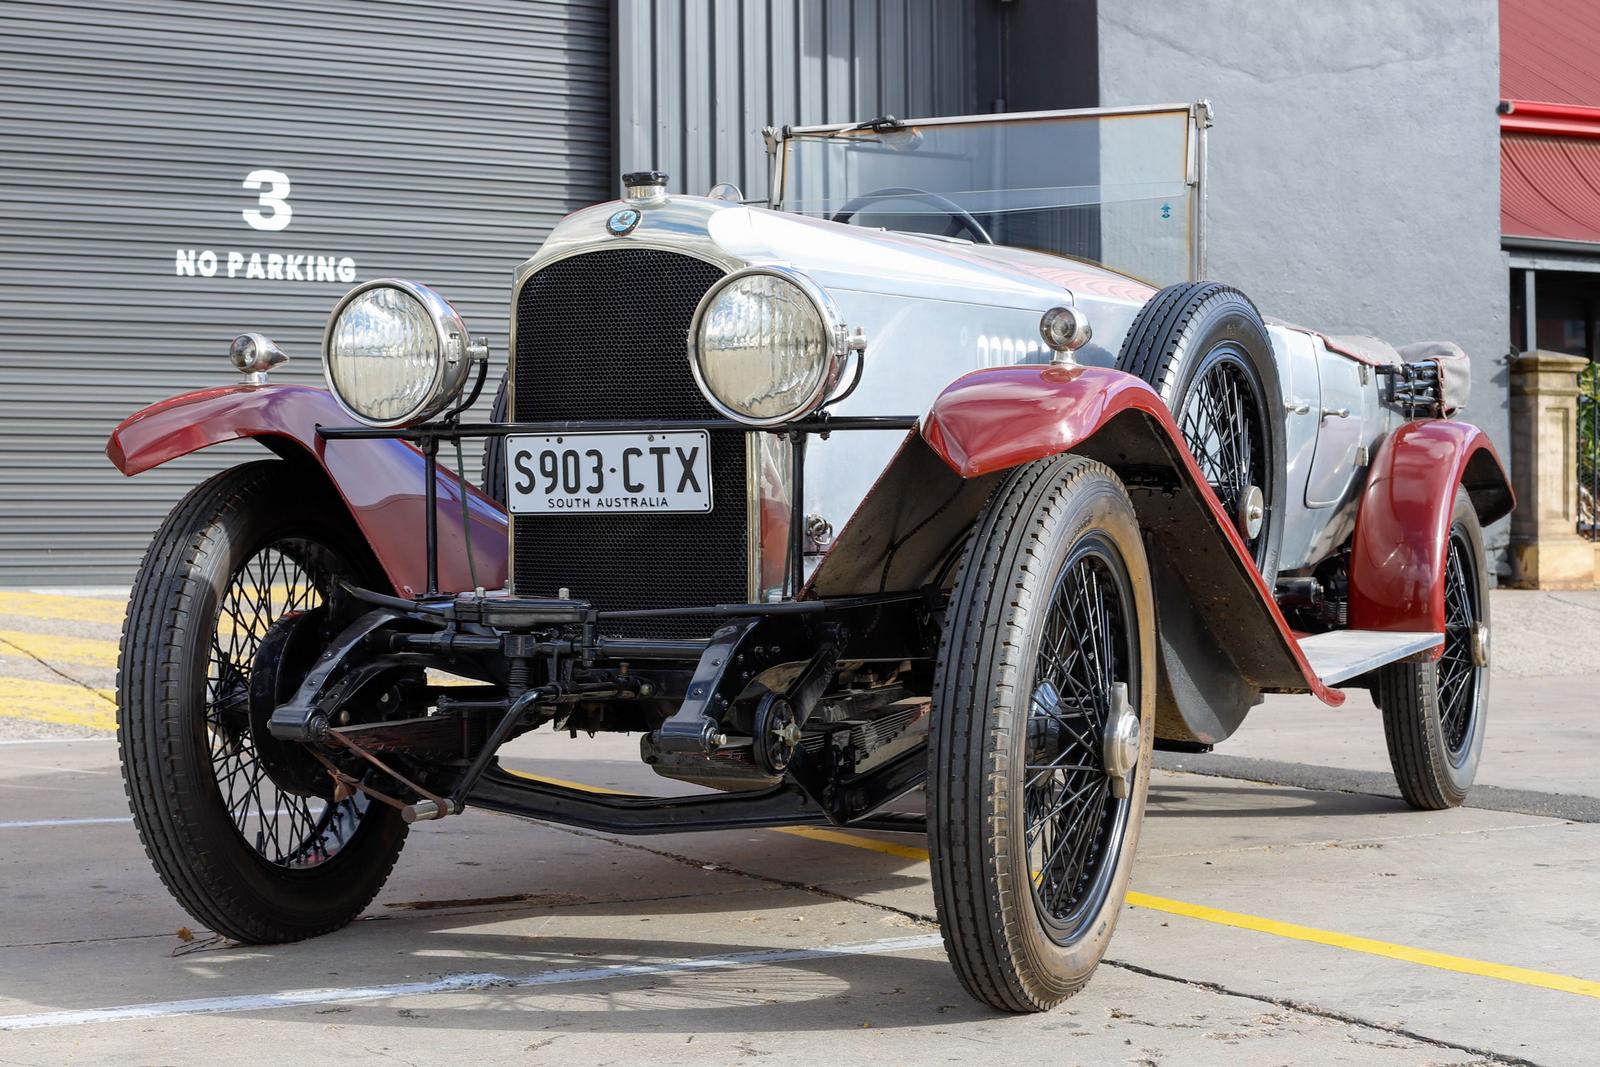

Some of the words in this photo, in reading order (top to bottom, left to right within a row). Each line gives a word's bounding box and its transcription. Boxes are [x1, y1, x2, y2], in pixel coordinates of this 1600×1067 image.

[242, 170, 293, 231] 3
[176, 249, 218, 277] NO
[227, 252, 356, 282] PARKING
[548, 498, 590, 508] SOUTH
[597, 497, 668, 508] AUSTRALIA
